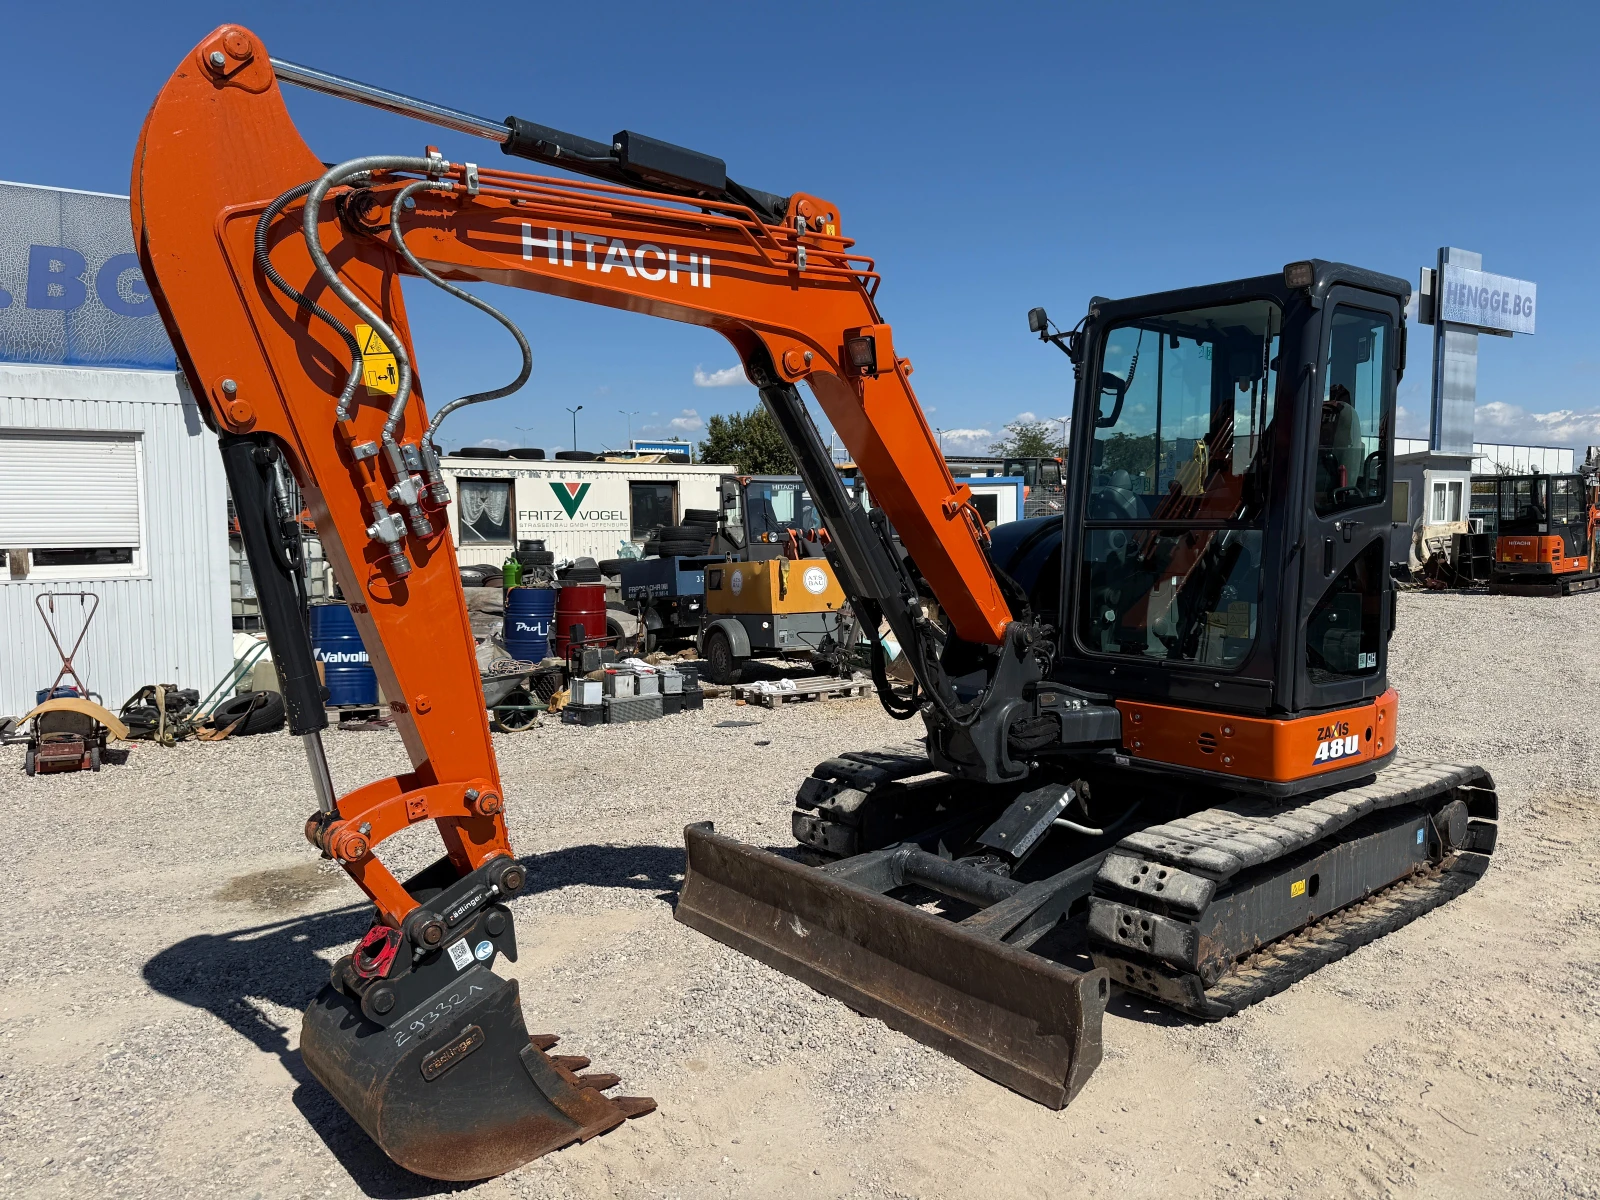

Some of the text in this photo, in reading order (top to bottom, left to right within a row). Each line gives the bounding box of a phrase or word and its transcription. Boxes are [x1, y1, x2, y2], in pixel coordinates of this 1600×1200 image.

[521, 222, 711, 288] HITACHI
[1446, 281, 1533, 318] HENGGE.BG
[518, 510, 628, 521] FRITZ VOGEL
[1317, 721, 1349, 741] ZAXIS
[1315, 735, 1359, 760] 48U
[449, 893, 483, 921] rädlinger
